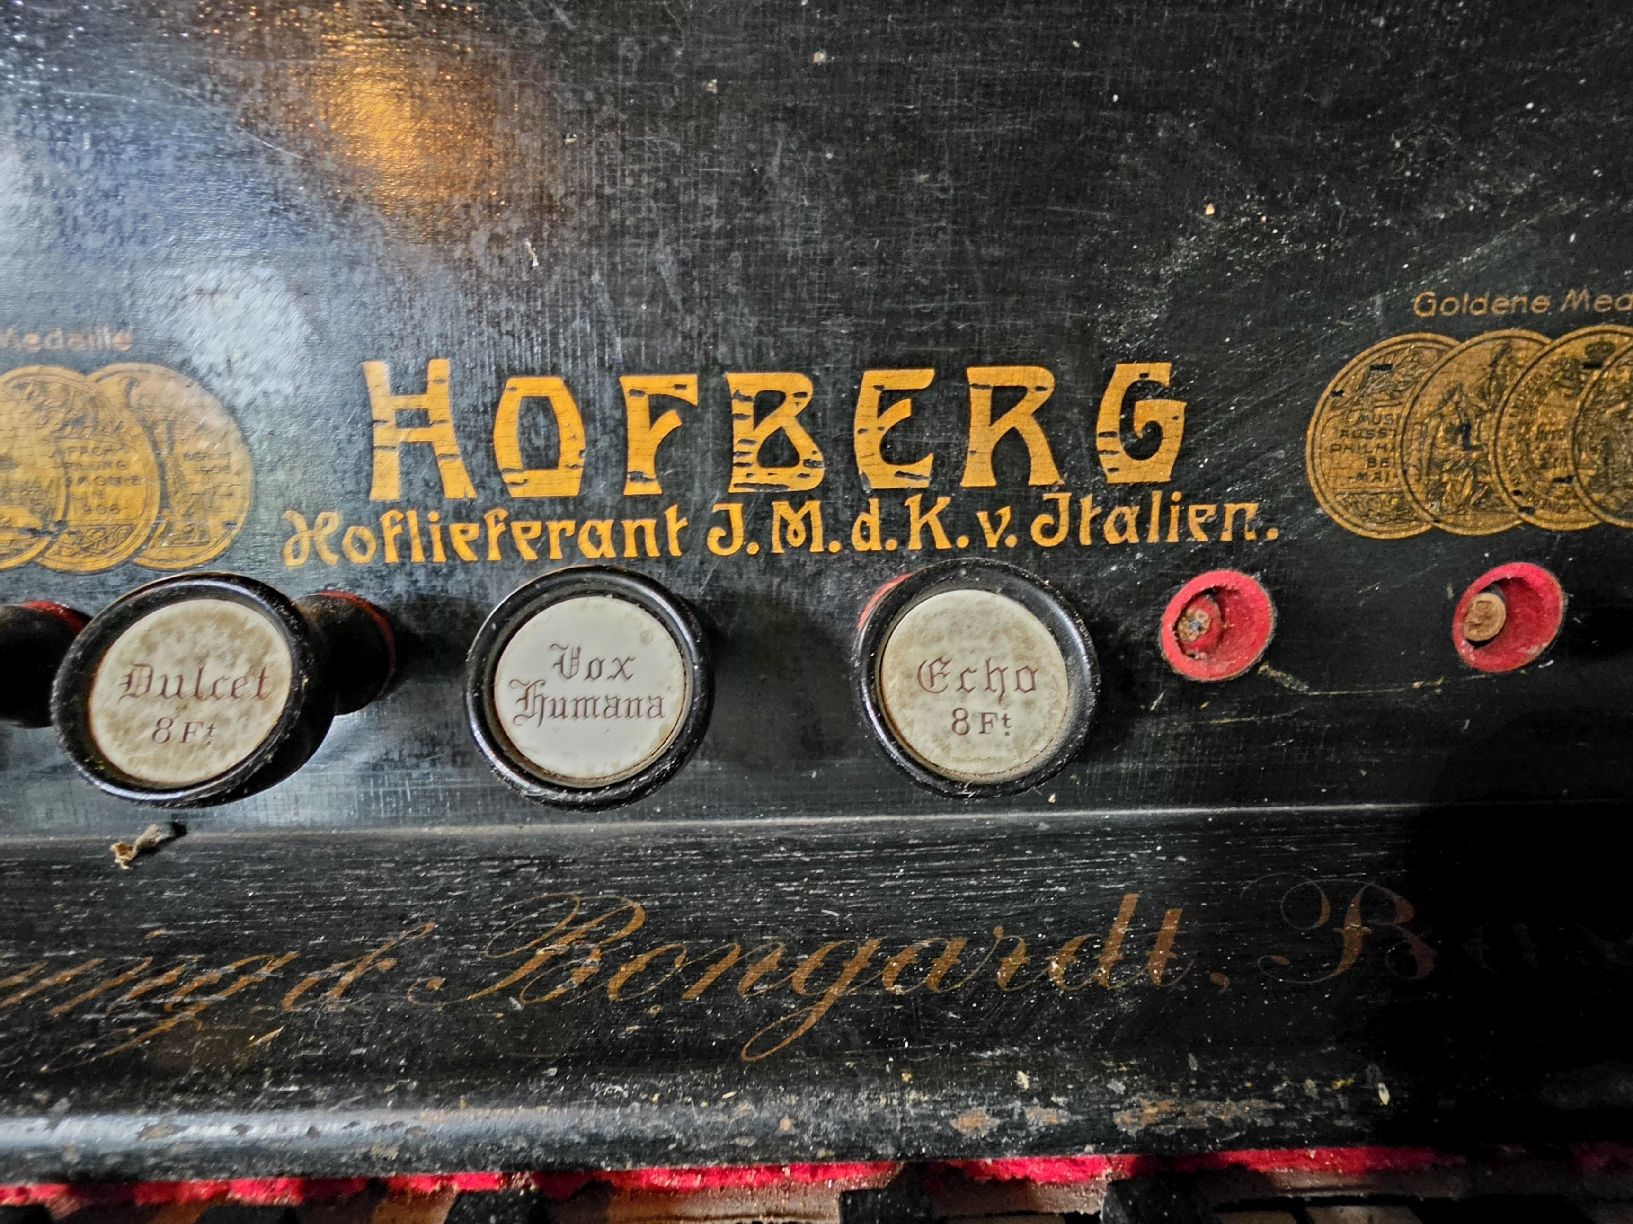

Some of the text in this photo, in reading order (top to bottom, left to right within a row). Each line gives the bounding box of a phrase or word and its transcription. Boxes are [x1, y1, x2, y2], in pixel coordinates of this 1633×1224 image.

[1413, 290, 1551, 319] Goldene
[361, 357, 1187, 502] HOFBERG
[282, 503, 689, 568] Hoflieferant
[118, 661, 274, 703] Dulcet
[549, 641, 637, 682] Vox
[916, 655, 1040, 706] Echo
[508, 677, 667, 729] Humana
